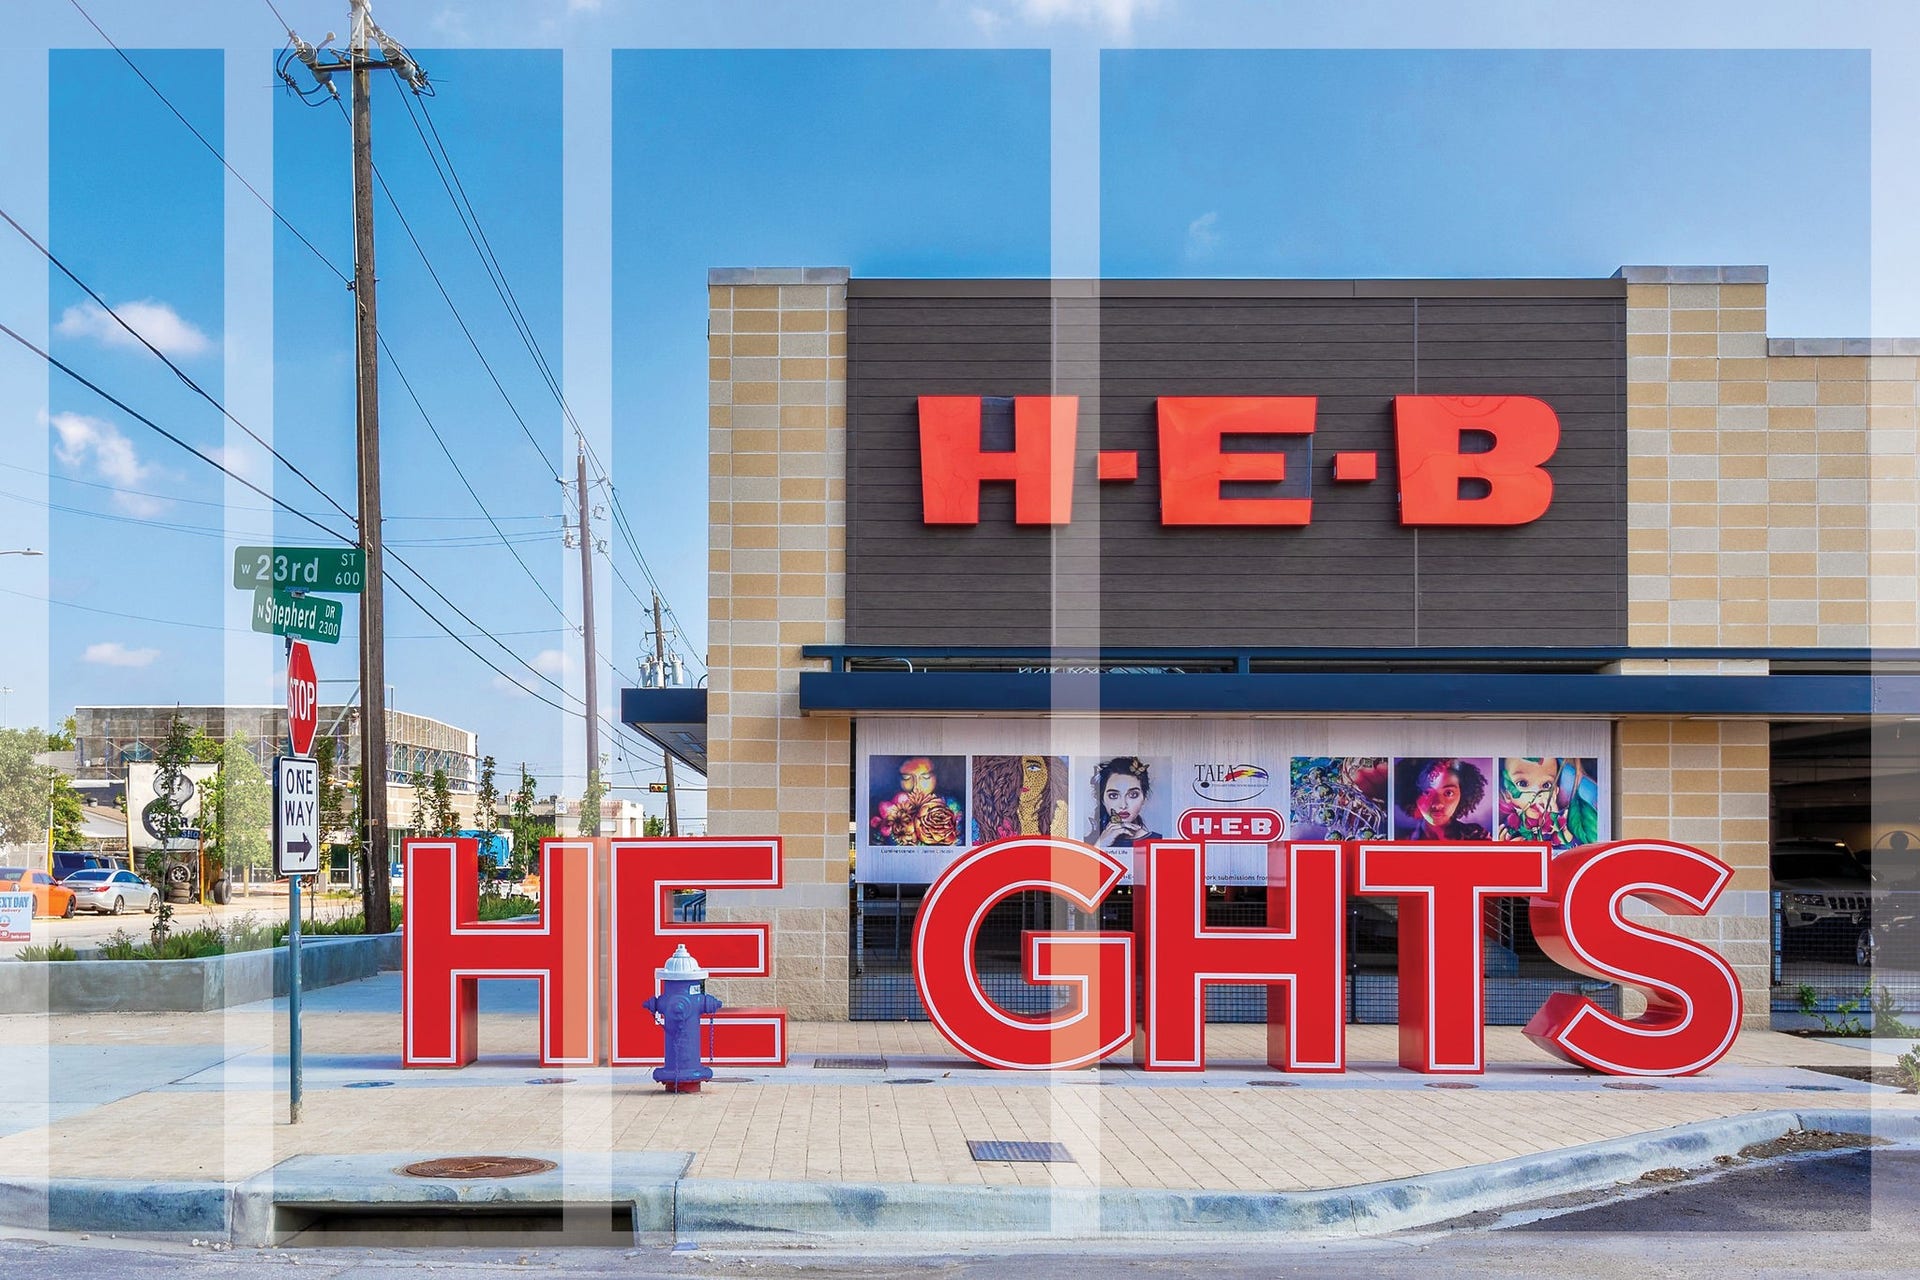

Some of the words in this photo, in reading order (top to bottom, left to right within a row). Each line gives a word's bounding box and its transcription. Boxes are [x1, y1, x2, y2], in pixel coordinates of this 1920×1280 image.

[917, 395, 1561, 526] H-E-B
[241, 564, 251, 574] W
[255, 554, 319, 583] 23rd
[341, 553, 356, 566] ST
[335, 571, 360, 586] 600
[257, 604, 264, 619] N
[264, 597, 317, 632] Shepherd
[325, 604, 336, 618] DR
[318, 620, 339, 637] 2300
[288, 678, 315, 721] STOP
[286, 768, 313, 795] ONE
[1194, 764, 1236, 782] TAEA
[285, 801, 314, 826] WAY
[181, 830, 199, 839] SHO
[1191, 817, 1272, 835] H-E-B
[13, 896, 30, 908] DAY
